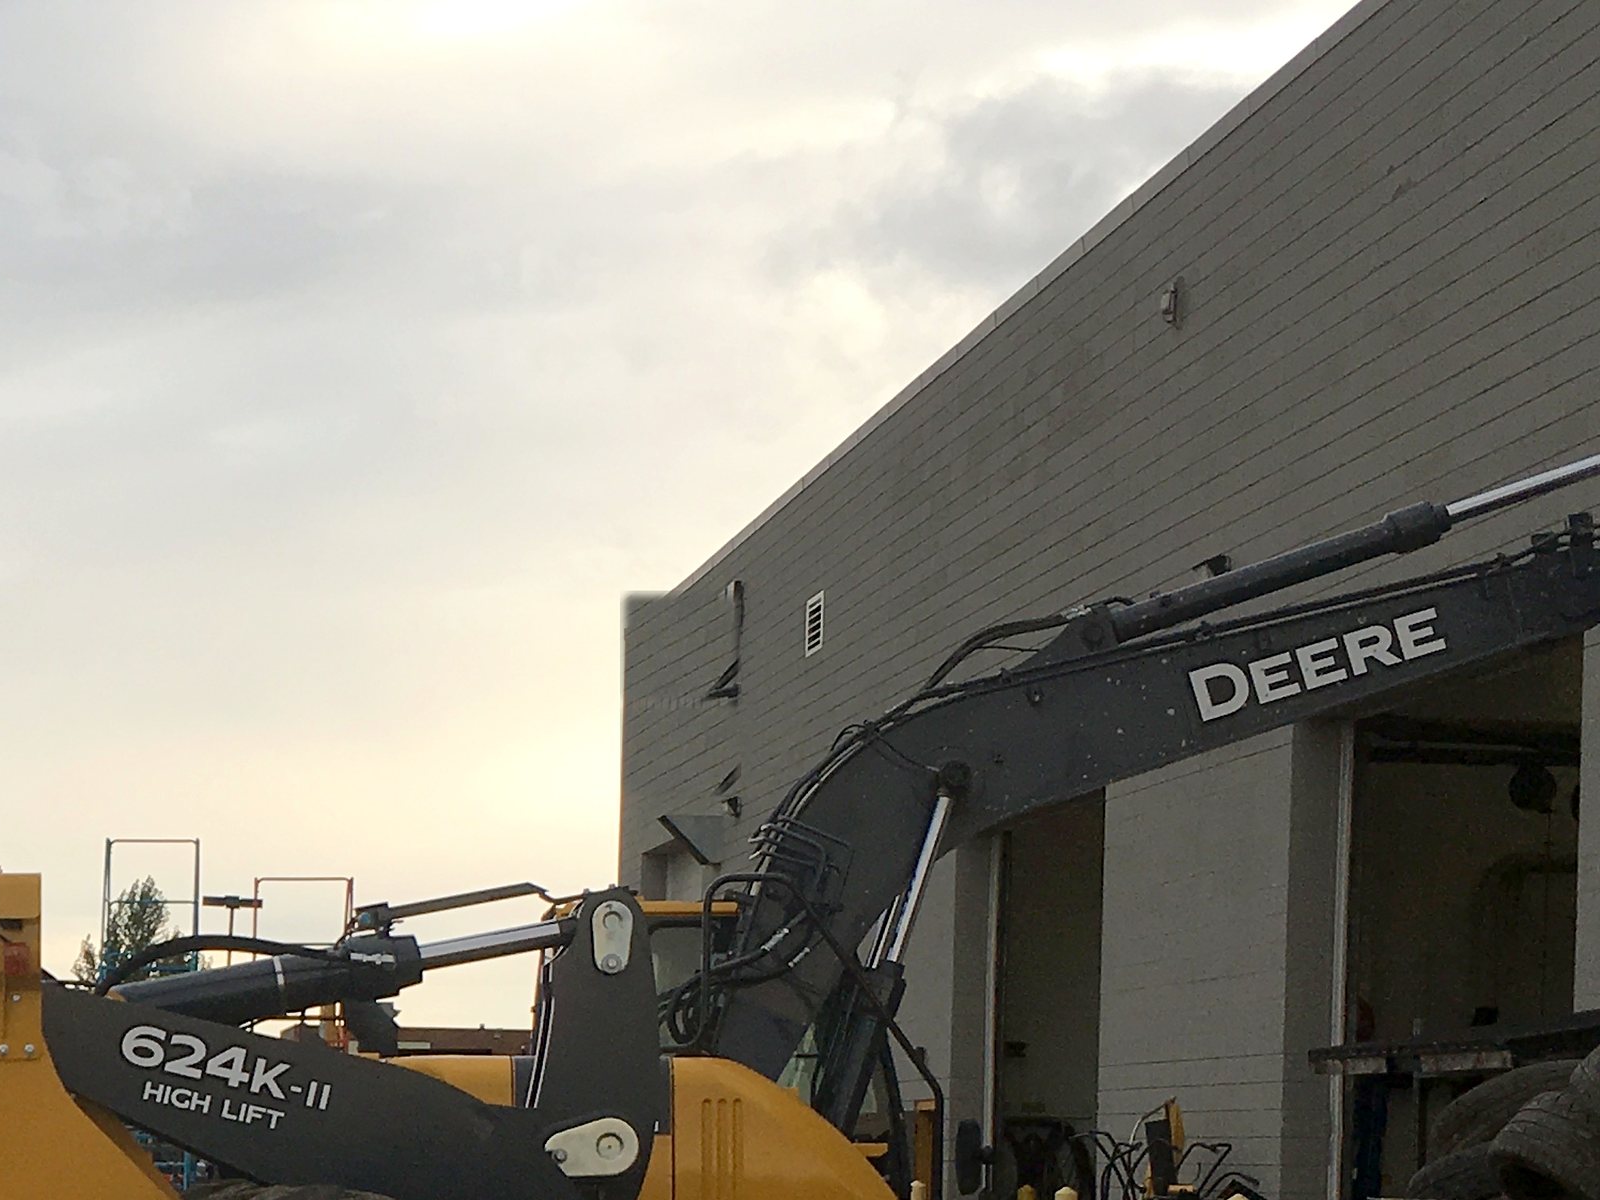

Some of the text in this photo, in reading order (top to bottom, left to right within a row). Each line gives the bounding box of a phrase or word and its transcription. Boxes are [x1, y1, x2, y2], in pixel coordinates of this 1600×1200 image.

[1188, 606, 1447, 722] DEERE
[121, 1026, 332, 1111] 624K-II
[142, 1081, 286, 1130] HIGH LIFT
